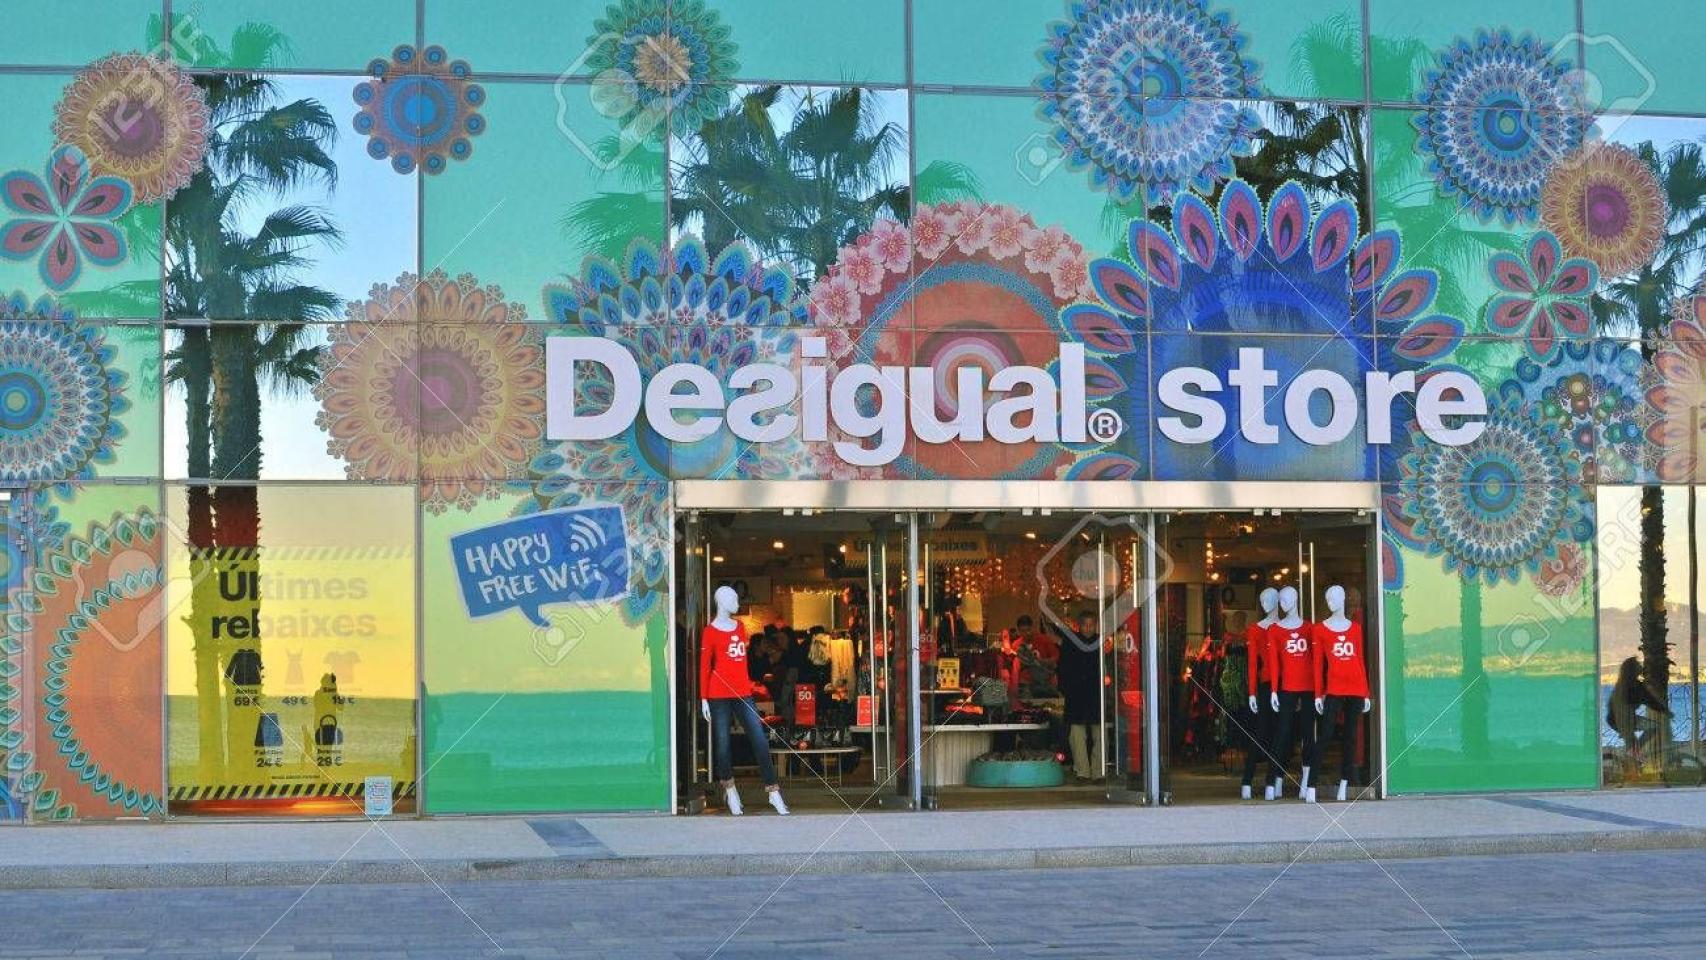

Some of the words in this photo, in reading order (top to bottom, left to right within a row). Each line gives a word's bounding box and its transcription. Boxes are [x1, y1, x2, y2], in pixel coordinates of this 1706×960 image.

[1158, 347, 1488, 445] store
[465, 532, 550, 576] HAPPY
[478, 574, 538, 604] FREE
[211, 608, 378, 639] rebaixes
